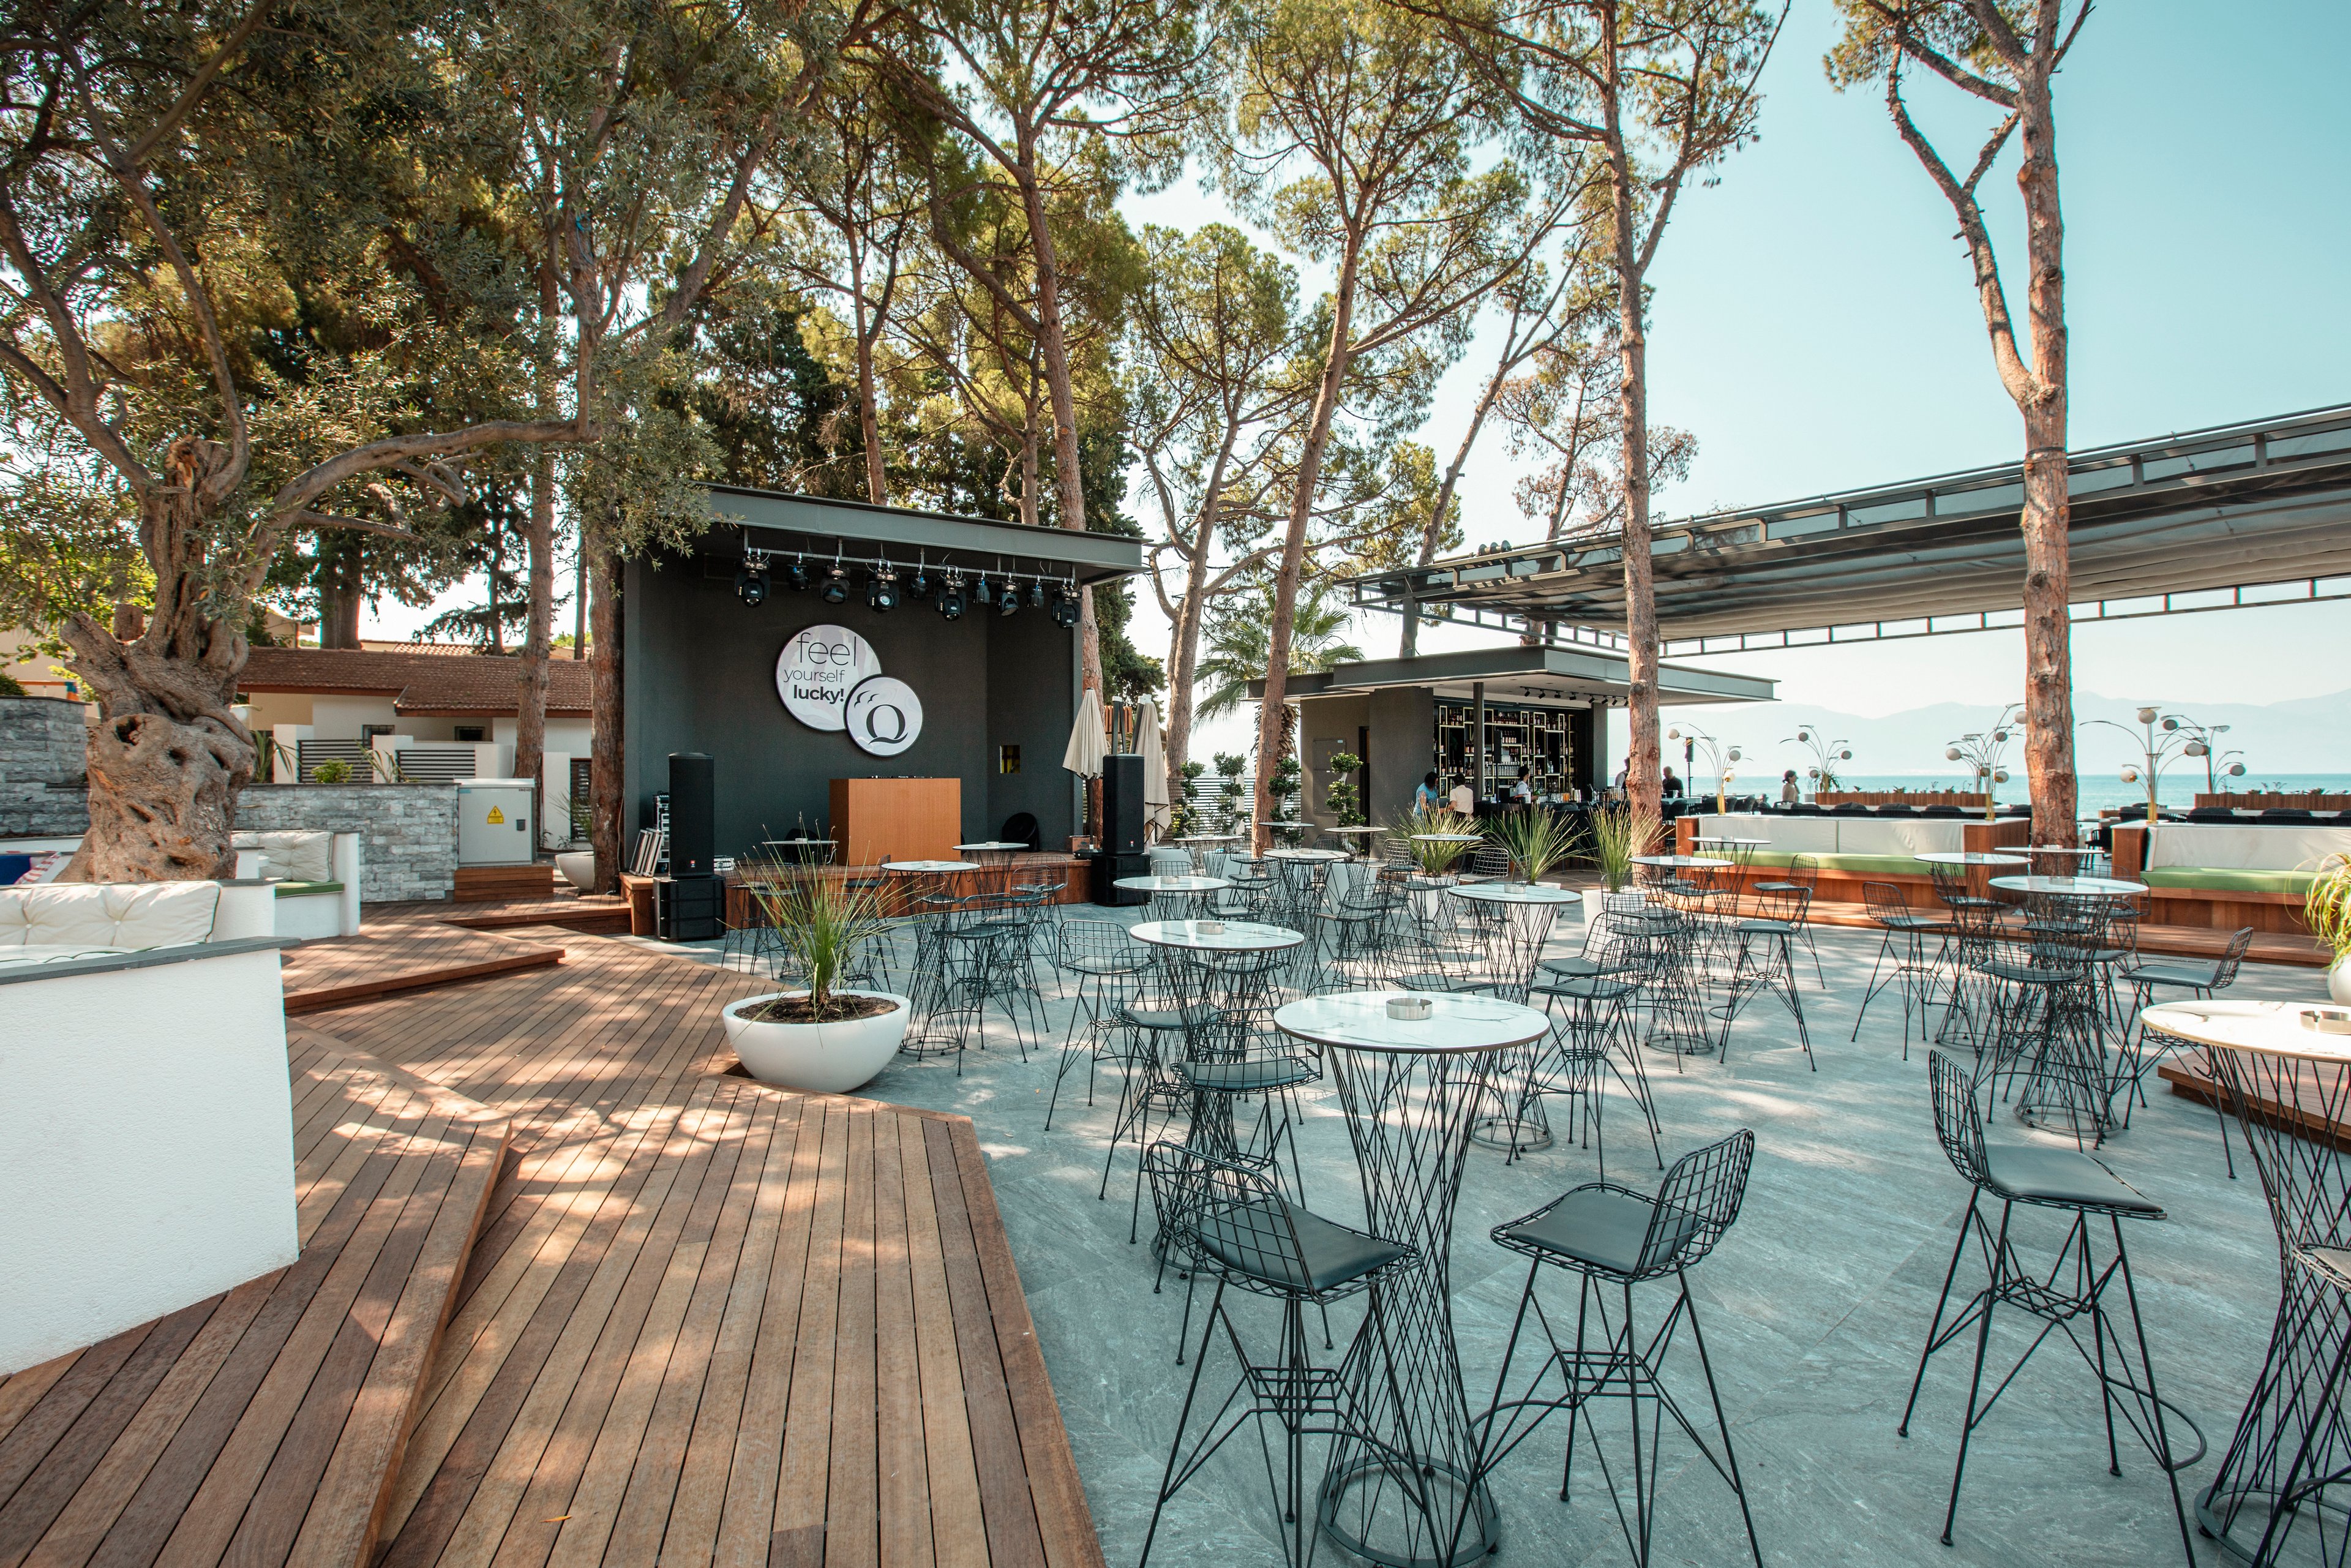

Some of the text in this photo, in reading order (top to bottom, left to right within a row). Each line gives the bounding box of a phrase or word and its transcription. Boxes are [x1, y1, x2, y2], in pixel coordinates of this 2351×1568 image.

[797, 632, 857, 666] feel
[784, 669, 846, 683] yourself
[793, 685, 844, 704] lucky!
[866, 704, 909, 745] Q
